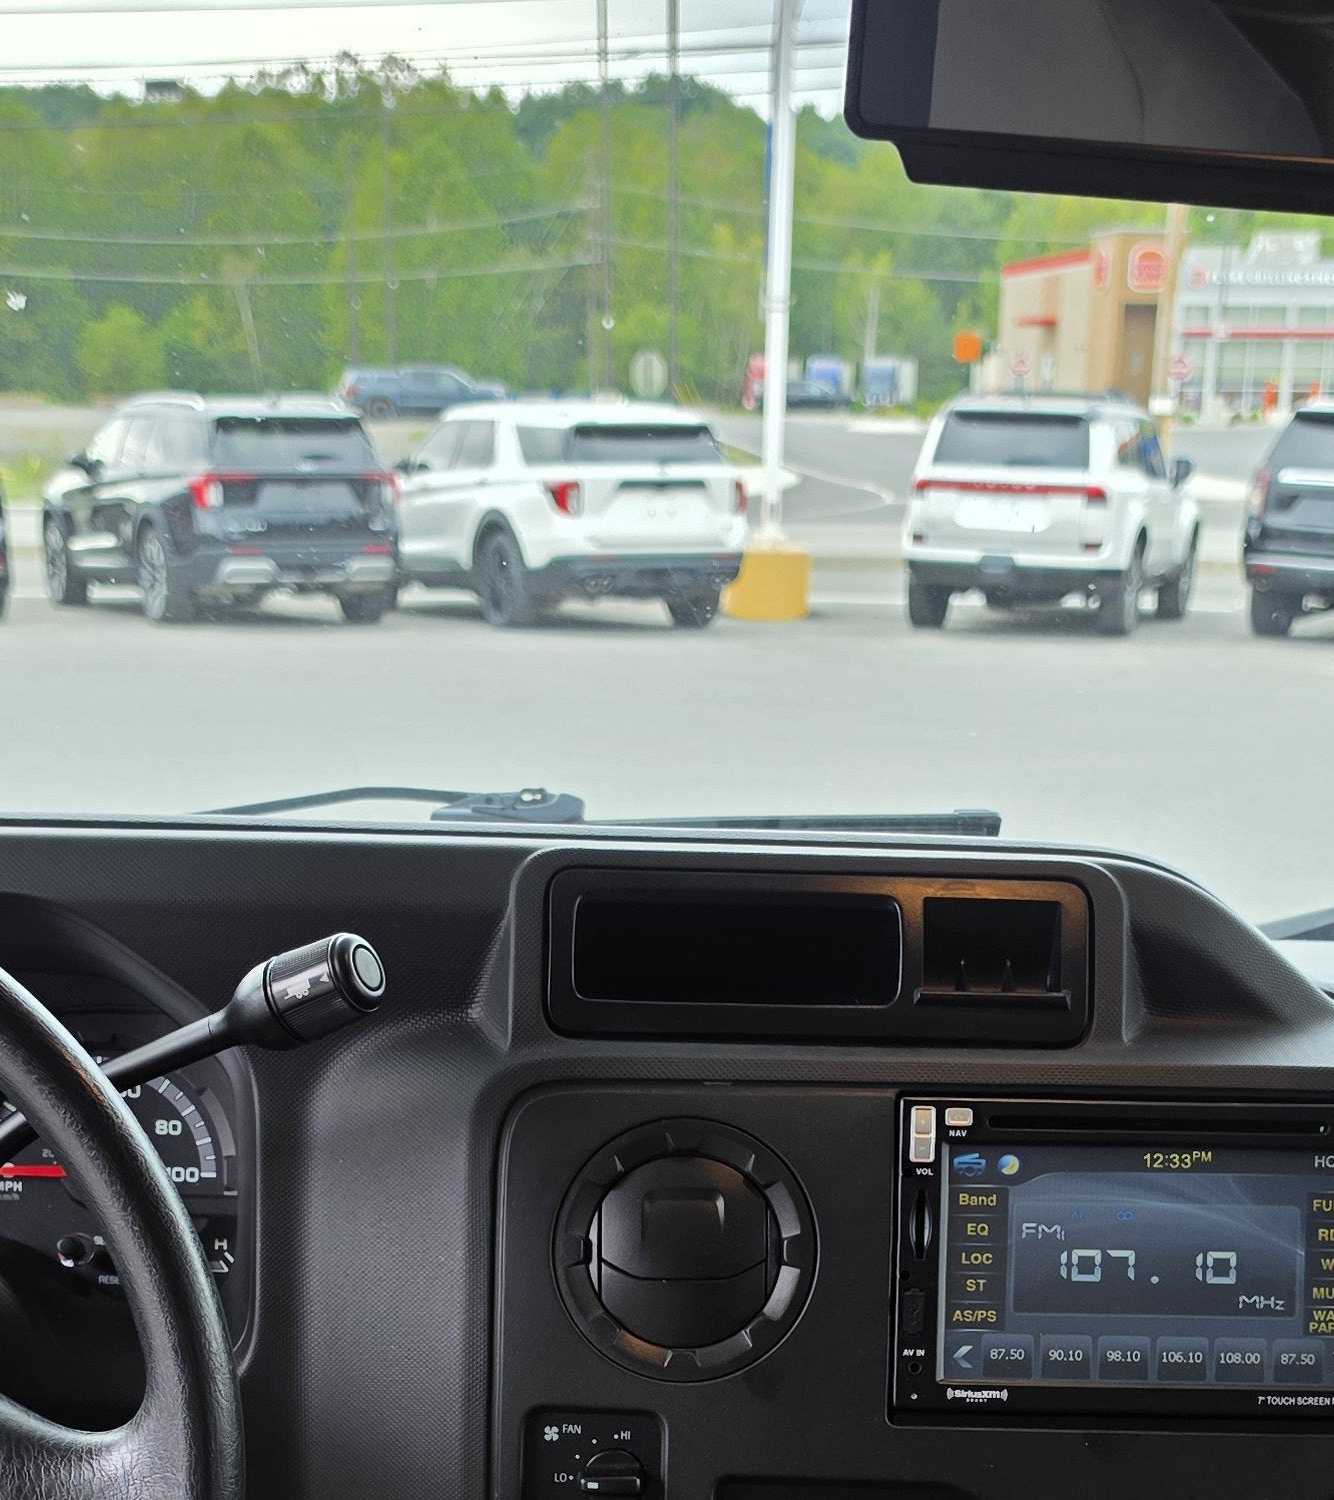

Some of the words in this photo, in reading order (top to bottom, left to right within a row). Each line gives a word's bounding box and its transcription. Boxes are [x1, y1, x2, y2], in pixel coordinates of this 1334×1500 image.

[155, 1118, 182, 1136] 80
[948, 1129, 968, 1138] NAV
[915, 1167, 934, 1176] VOL
[958, 1193, 997, 1207] Band
[966, 1222, 989, 1237] EQ
[214, 1238, 228, 1250] H
[961, 1251, 993, 1266] LOC
[99, 1275, 119, 1285] RESE
[966, 1278, 986, 1292] ST
[1238, 1294, 1286, 1311] MHz
[952, 1309, 997, 1324] AS/PS
[902, 1348, 915, 1357] AV
[916, 1348, 926, 1357] IN
[989, 1348, 1025, 1361] 87.50
[1048, 1349, 1083, 1362] 90.10
[1106, 1350, 1141, 1363] 98.10
[1161, 1350, 1203, 1364] 106.10
[1219, 1352, 1261, 1366] 108.00
[1280, 1353, 1316, 1366] 87.50
[1267, 1396, 1296, 1406] TOUCH
[1296, 1396, 1330, 1406] SCREEN
[561, 1424, 582, 1436] FAN
[620, 1430, 631, 1441] HI
[554, 1472, 567, 1483] LO
